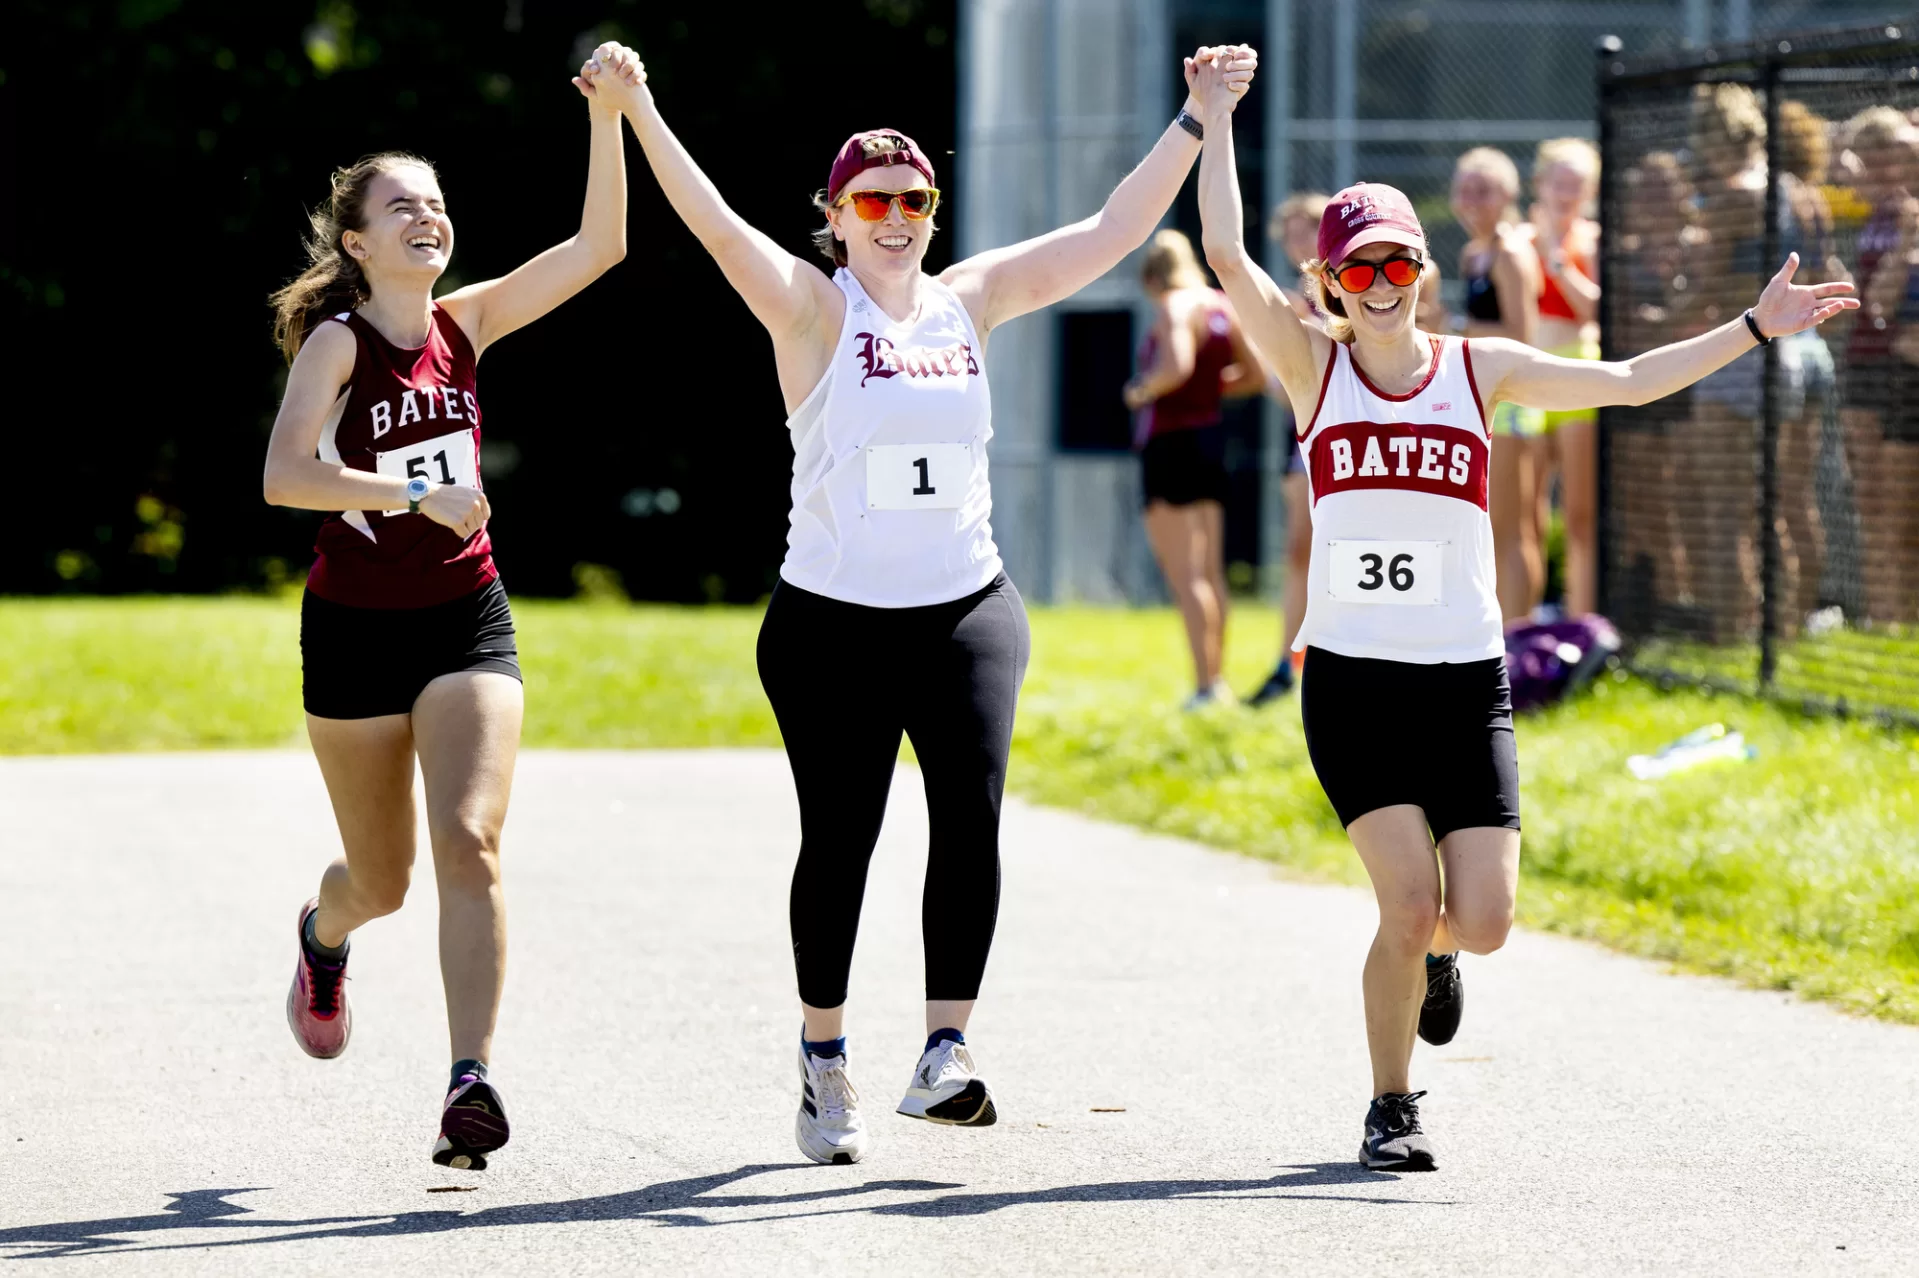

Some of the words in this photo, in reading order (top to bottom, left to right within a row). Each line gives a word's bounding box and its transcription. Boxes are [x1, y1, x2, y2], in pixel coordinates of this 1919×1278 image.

[854, 332, 979, 388] Bates
[370, 386, 478, 439] BATES
[406, 450, 456, 485] 51
[913, 458, 935, 495] 1
[1330, 436, 1471, 486] BATES
[1357, 553, 1415, 591] 36
